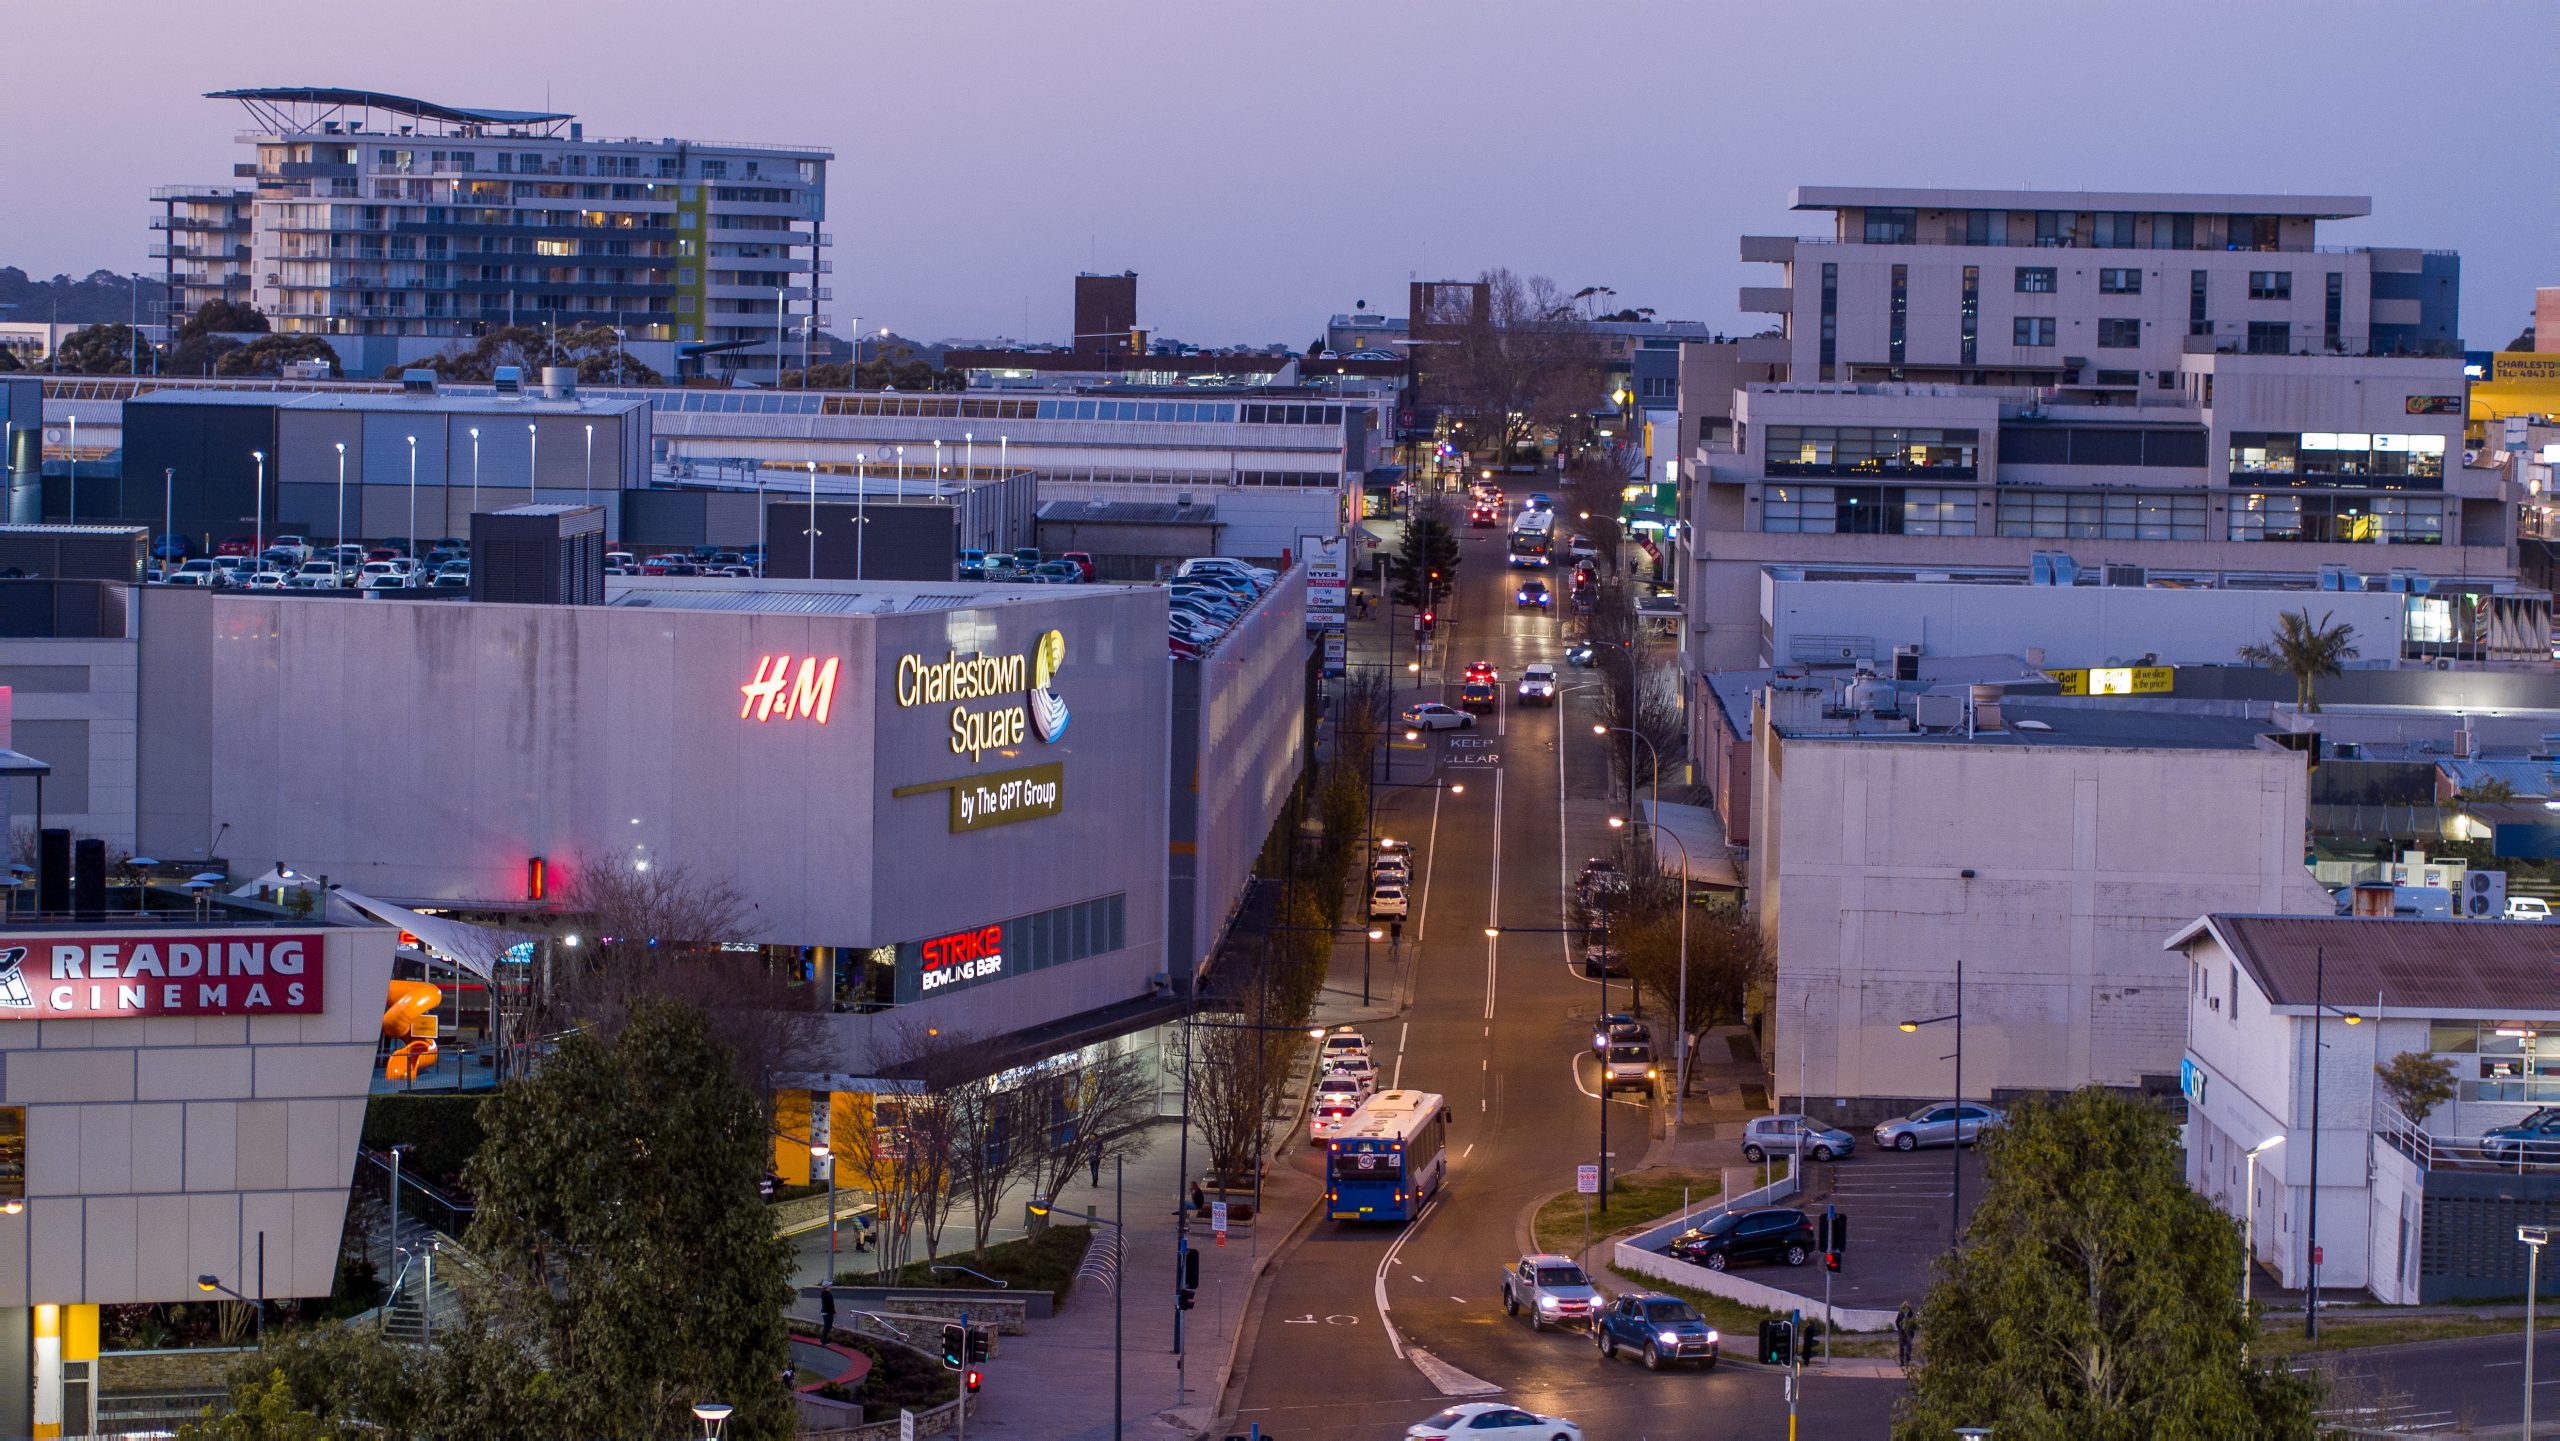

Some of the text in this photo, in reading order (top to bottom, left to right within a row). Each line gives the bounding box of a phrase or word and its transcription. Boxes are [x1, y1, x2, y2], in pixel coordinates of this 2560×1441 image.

[2496, 360, 2560, 369] CHARLESTO
[2520, 370, 2546, 378] 4943
[741, 655, 840, 725] H&M
[897, 650, 1026, 707] Charlestown
[2058, 671, 2078, 683] Golf
[952, 706, 1025, 763] Square
[1450, 739, 1494, 748] KEEP
[1443, 754, 1499, 764] CLEAR
[961, 779, 1056, 824] by The GPT Group
[51, 941, 305, 980] READING
[922, 925, 1002, 971] STRIKE
[922, 961, 975, 990] BOWLING
[50, 983, 305, 1011] CINEMAS
[1361, 1158, 1371, 1166] 40
